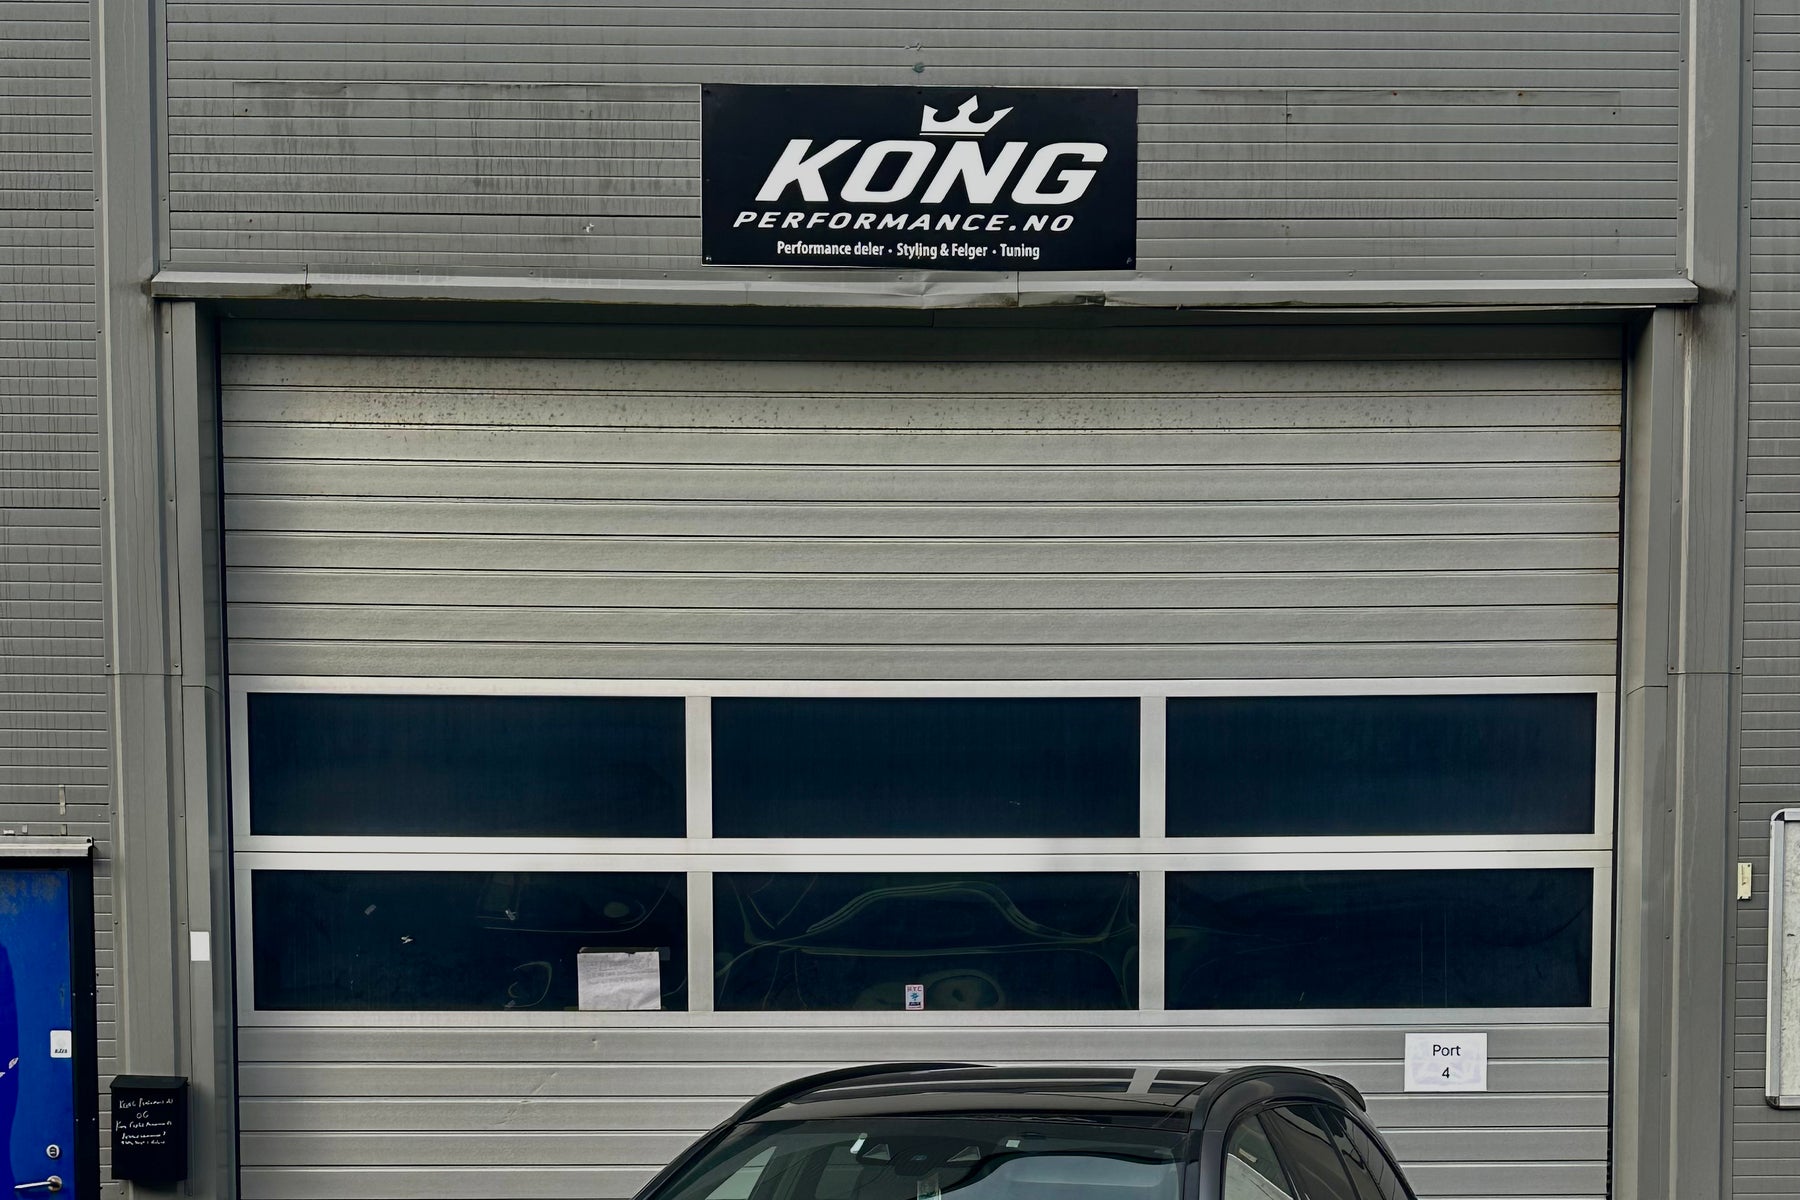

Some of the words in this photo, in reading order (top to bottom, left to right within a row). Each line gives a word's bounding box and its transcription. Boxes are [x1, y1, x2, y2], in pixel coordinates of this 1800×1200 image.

[755, 139, 1107, 204] KONG
[733, 212, 1074, 231] PERFORMANCE.NO
[777, 241, 852, 255] Performance
[854, 242, 885, 255] deler
[897, 243, 938, 259] Styling
[940, 243, 950, 256] &
[952, 243, 988, 259] Felger
[1000, 244, 1040, 260] Tuning
[1432, 1044, 1461, 1057] Port
[1441, 1067, 1450, 1079] 4
